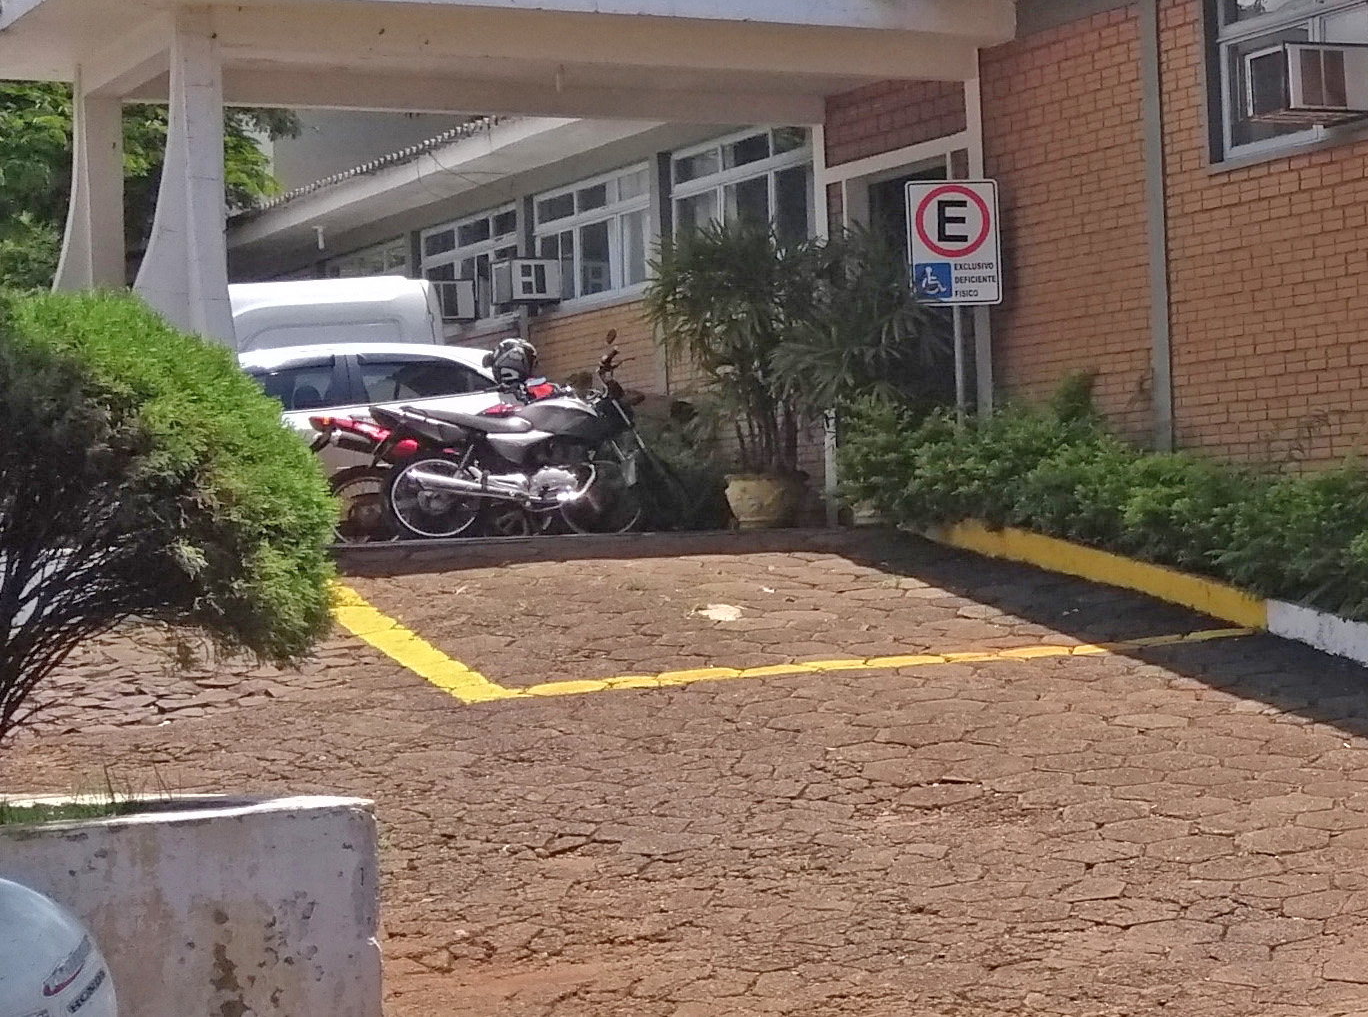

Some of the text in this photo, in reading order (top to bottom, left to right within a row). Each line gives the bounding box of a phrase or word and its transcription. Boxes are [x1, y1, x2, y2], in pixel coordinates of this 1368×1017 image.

[938, 200, 968, 242] E
[954, 262, 994, 271] EXCLUSIVO
[955, 275, 997, 284] DEFICIENTE
[955, 289, 979, 297] FISICO
